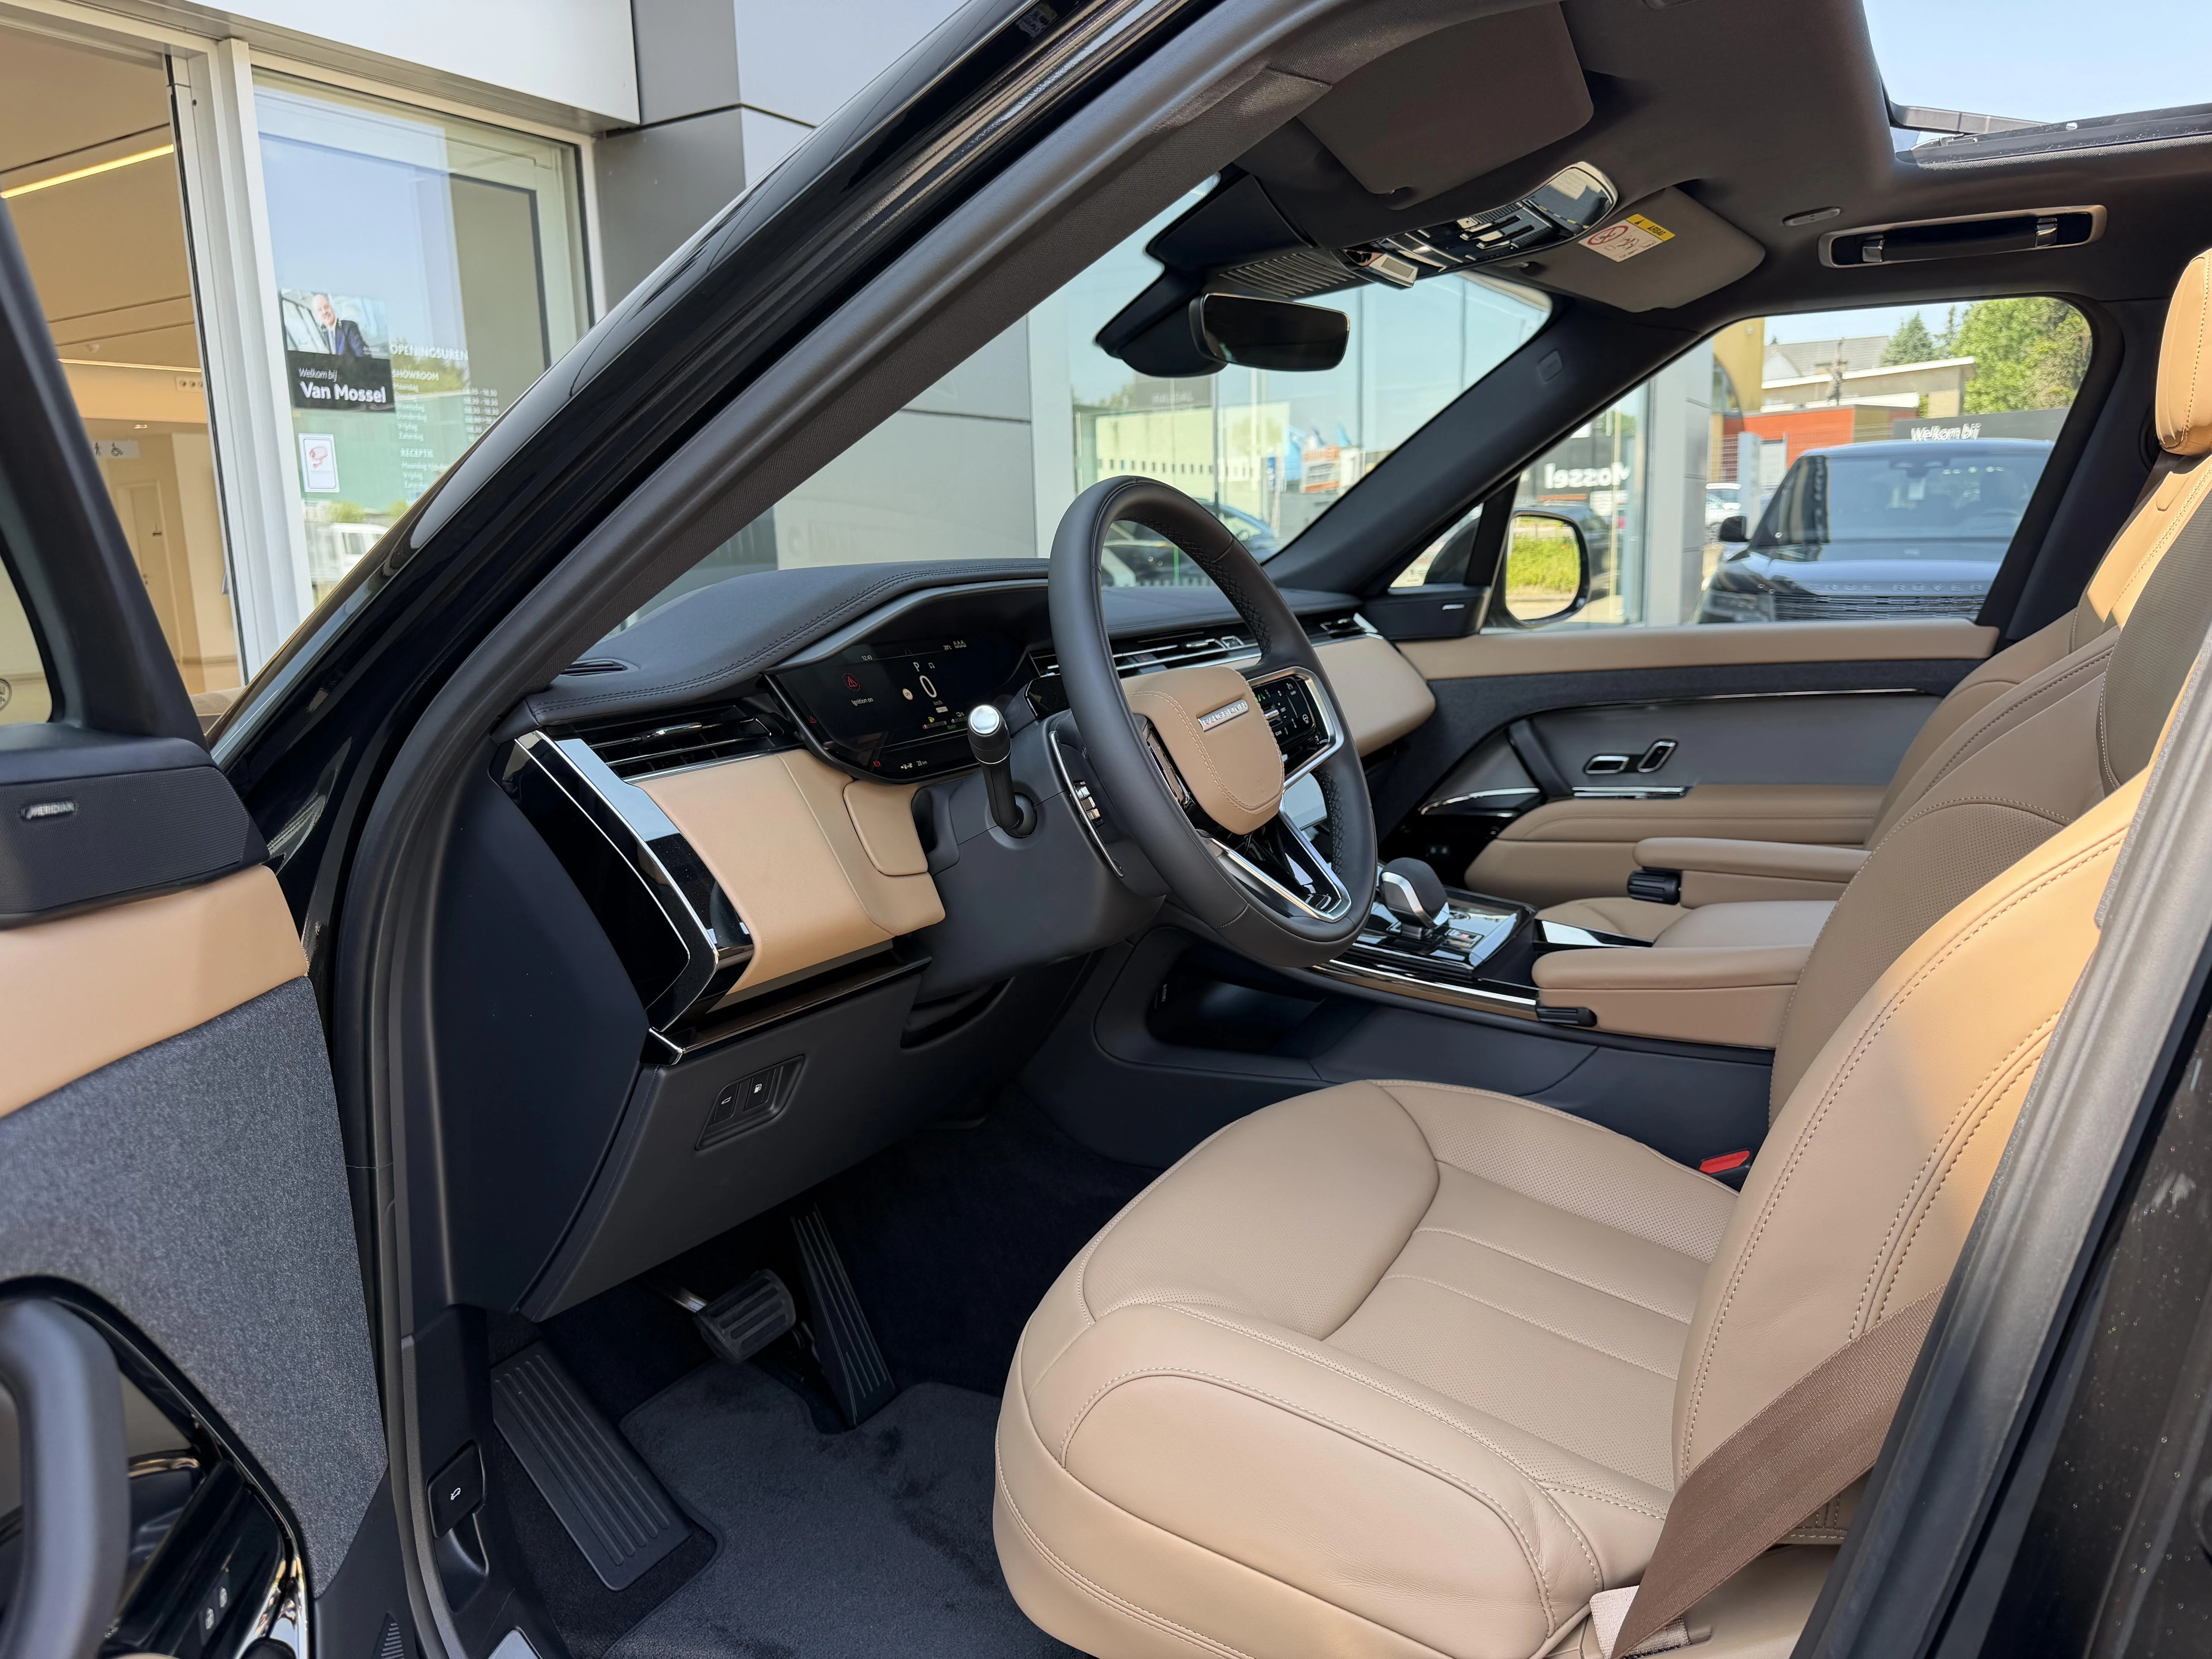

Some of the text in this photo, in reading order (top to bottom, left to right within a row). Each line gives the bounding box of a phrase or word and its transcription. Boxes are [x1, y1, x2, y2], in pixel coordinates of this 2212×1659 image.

[299, 367, 337, 382] Welkom bij
[392, 369, 439, 381] SHOWROOM
[300, 381, 331, 399] Van
[334, 383, 386, 404] Mossel
[1911, 426, 1961, 441] Welkom
[1892, 582, 1984, 592] ROVER
[913, 662, 920, 672] P
[919, 675, 937, 698] 0
[1202, 702, 1247, 726] RANGE ROVER
[26, 802, 75, 820] MERIDIAN
